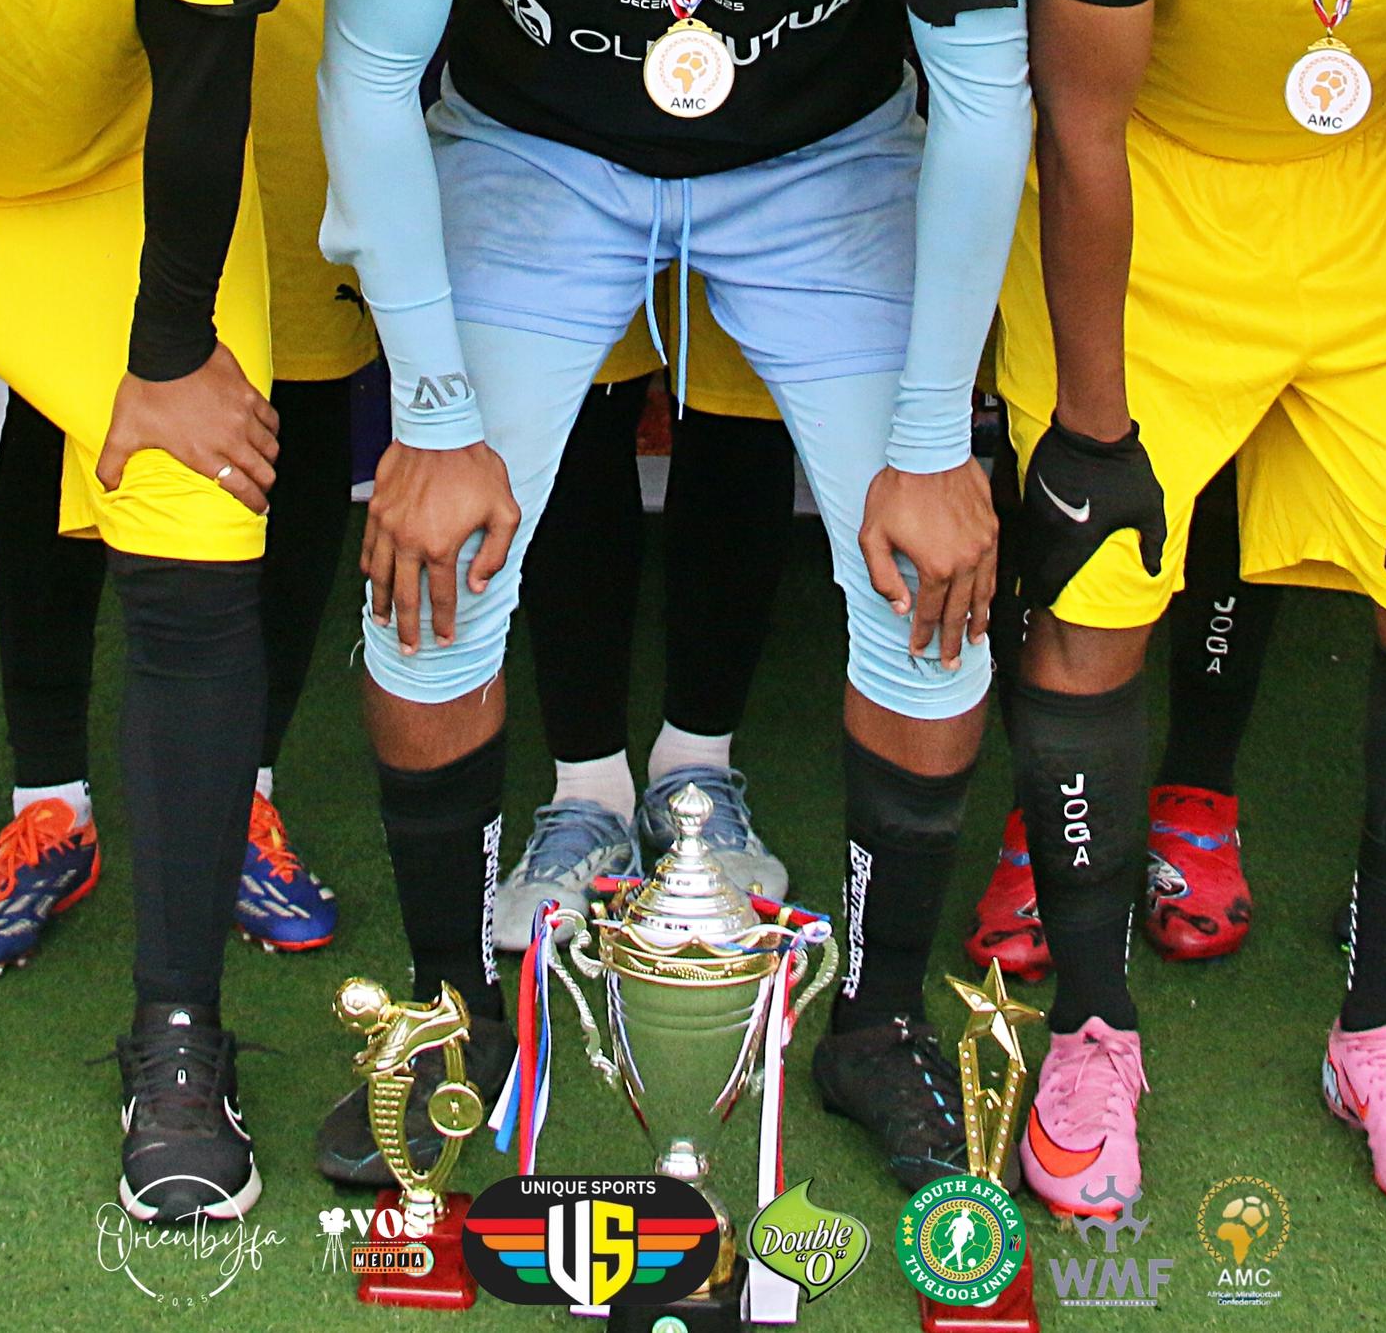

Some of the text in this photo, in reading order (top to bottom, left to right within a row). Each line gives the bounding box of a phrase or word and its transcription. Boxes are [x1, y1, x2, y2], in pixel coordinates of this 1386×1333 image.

[570, 29, 649, 61] OL
[670, 96, 707, 111] AMC
[1306, 114, 1343, 129] AMC
[1207, 596, 1235, 673] JOGA
[1060, 773, 1091, 867] JOGA
